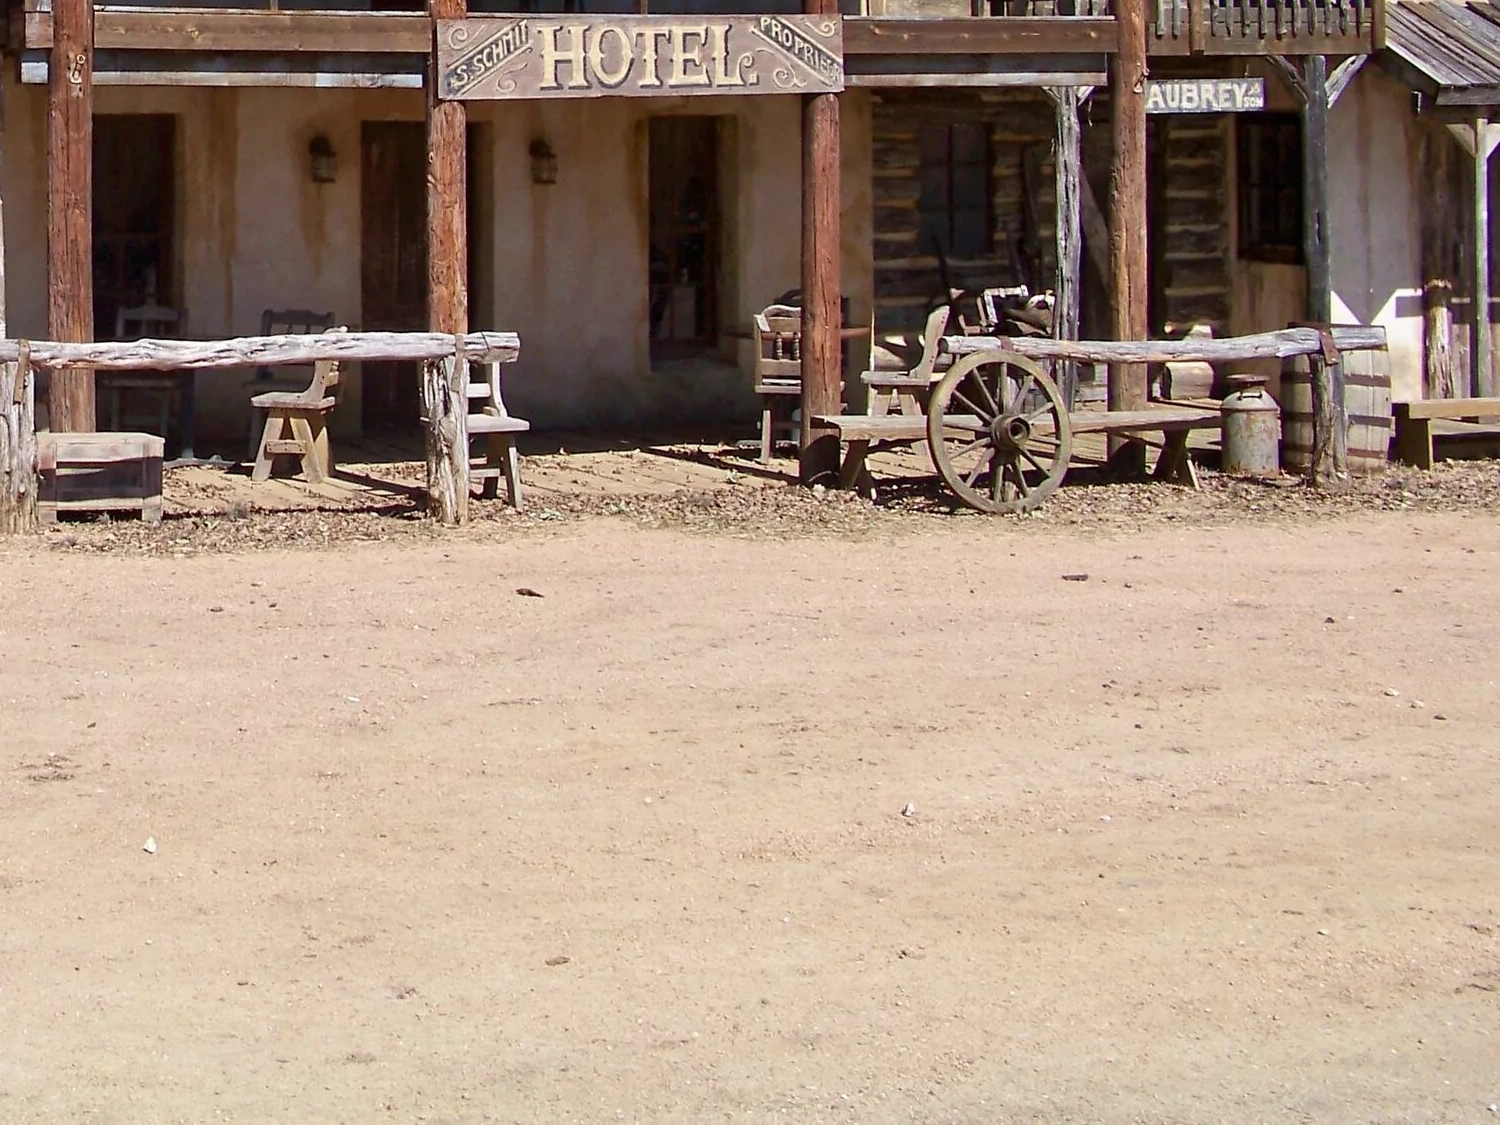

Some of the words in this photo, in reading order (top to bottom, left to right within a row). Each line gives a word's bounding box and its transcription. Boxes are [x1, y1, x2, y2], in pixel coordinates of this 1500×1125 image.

[473, 19, 529, 77] SCHMIT
[1147, 82, 1247, 108] AUBREY
[1243, 96, 1264, 108] SON
